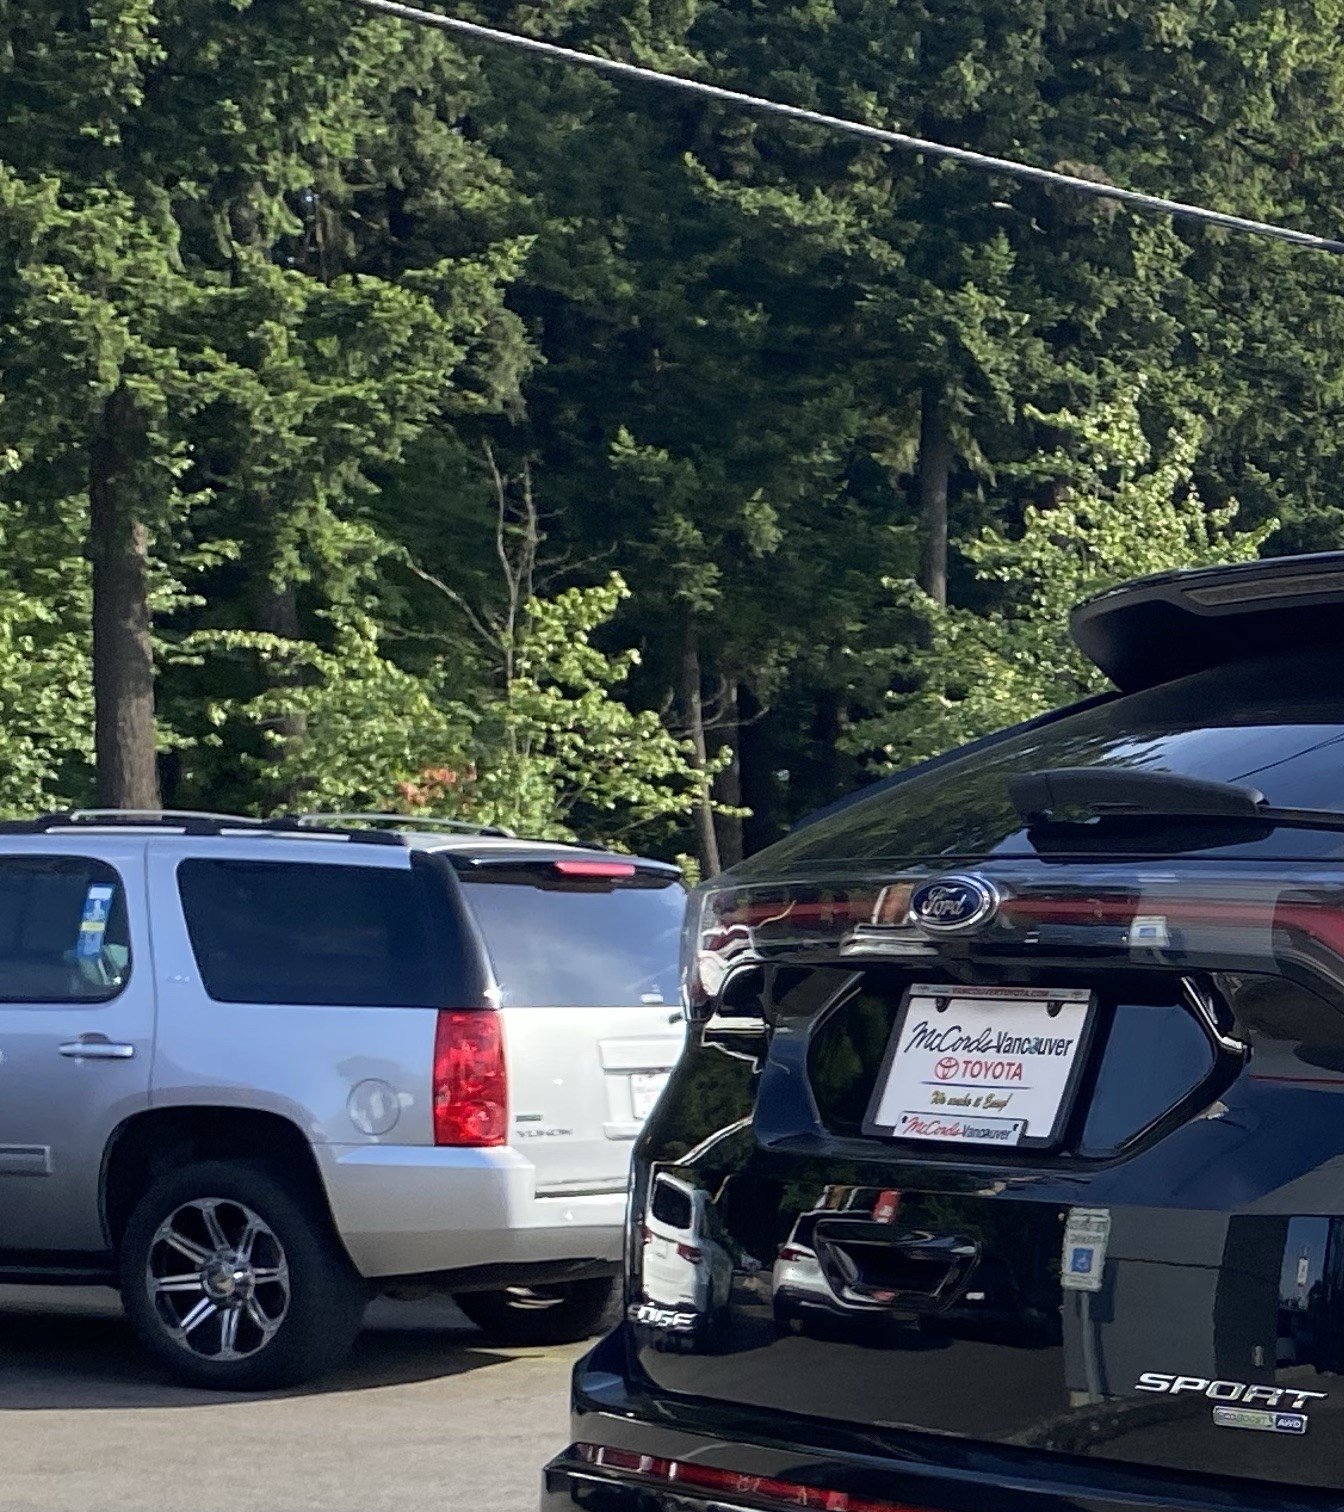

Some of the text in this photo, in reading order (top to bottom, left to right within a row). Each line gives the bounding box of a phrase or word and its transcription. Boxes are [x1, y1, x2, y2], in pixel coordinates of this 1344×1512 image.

[921, 886, 967, 916] Ford
[961, 1060, 1024, 1080] TOYOTA
[1134, 1372, 1329, 1409] SPORT
[1278, 1418, 1301, 1428] AWD
